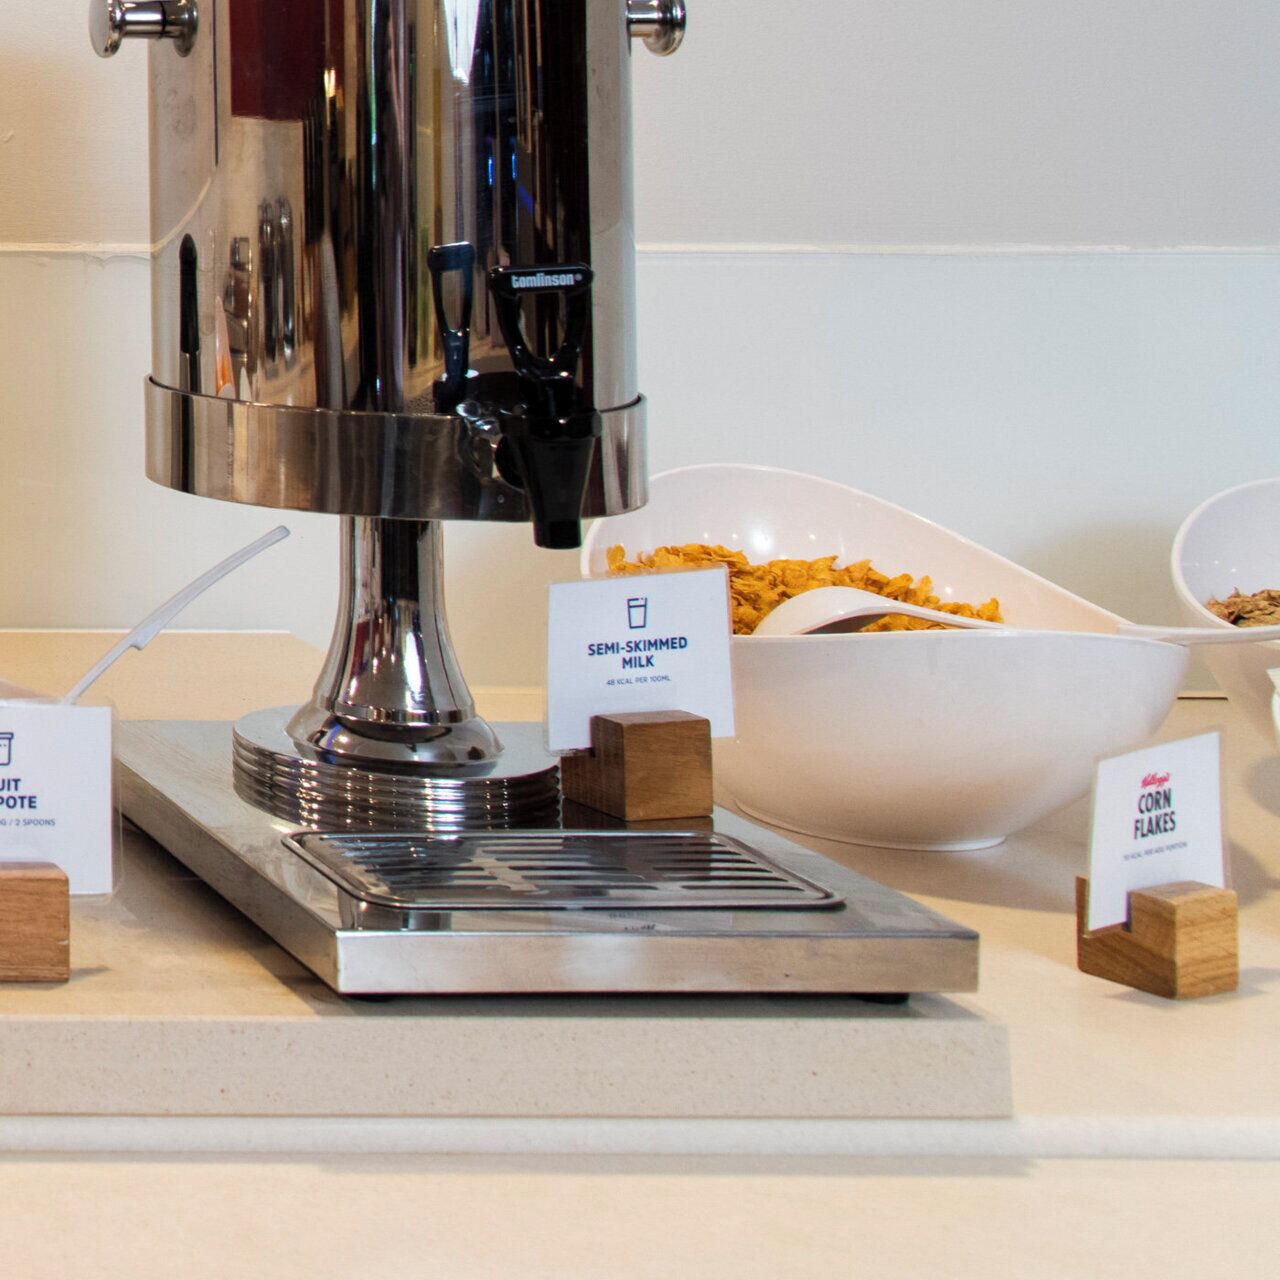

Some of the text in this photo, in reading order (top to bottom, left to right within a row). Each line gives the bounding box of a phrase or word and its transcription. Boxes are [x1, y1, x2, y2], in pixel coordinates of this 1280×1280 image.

[511, 273, 575, 288] tomlinson
[588, 636, 688, 656] SEMI-SKIMMED
[622, 655, 655, 669] MILK
[1138, 788, 1172, 814] CORN
[1134, 811, 1176, 840] FLAKES
